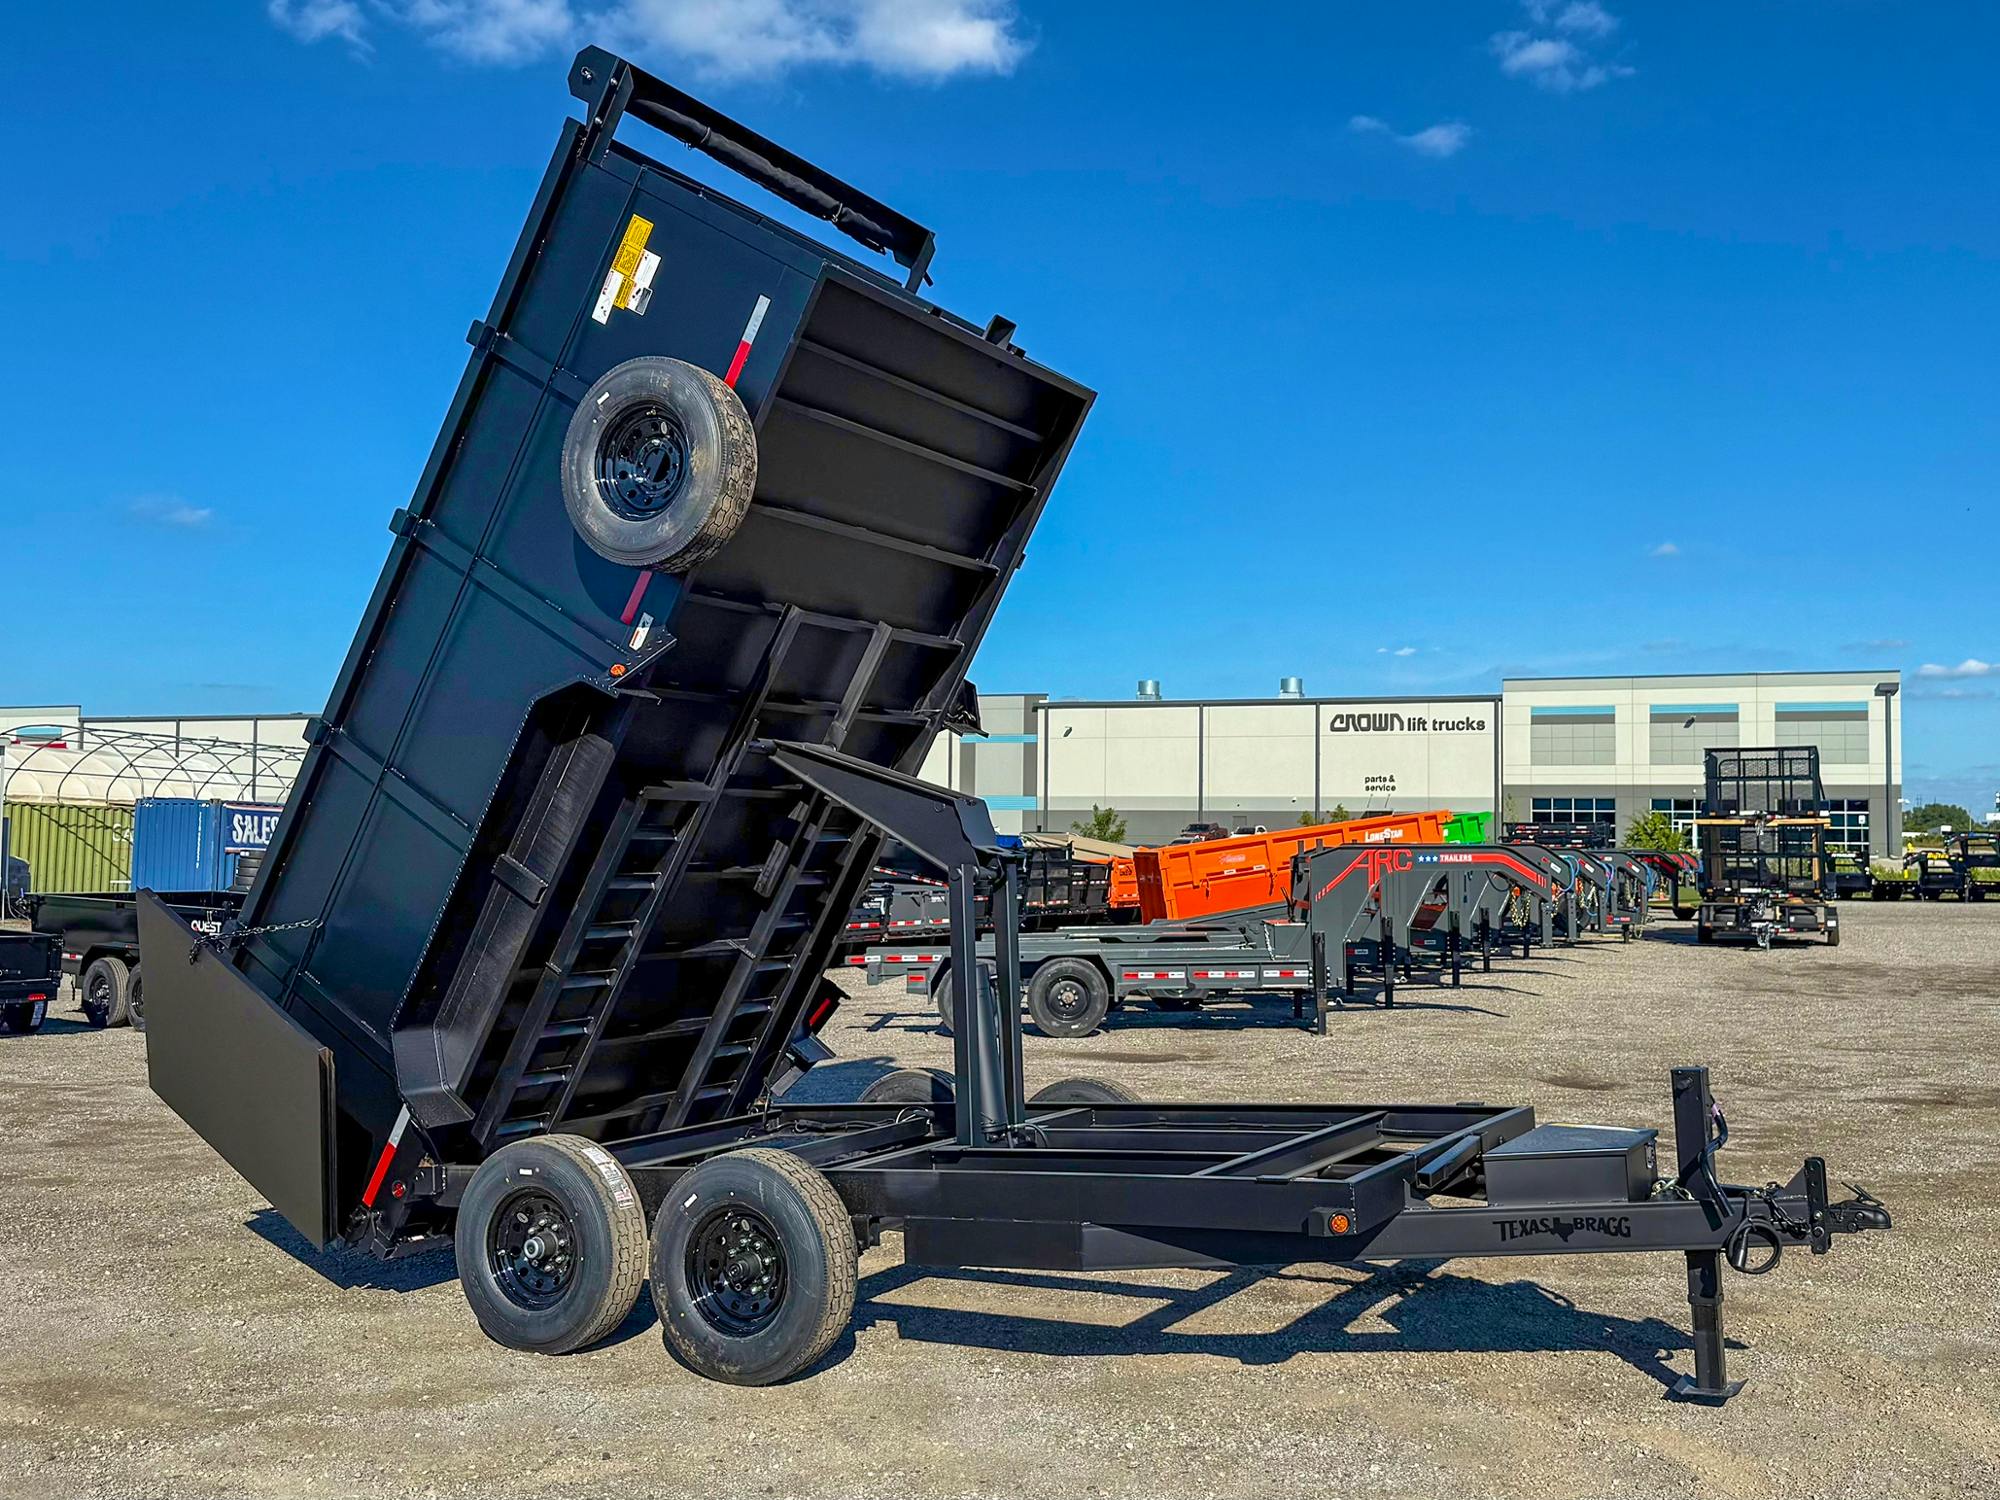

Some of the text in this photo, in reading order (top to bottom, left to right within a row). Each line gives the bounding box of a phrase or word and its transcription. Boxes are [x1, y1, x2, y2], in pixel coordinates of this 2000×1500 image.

[1330, 713, 1486, 732] CROWN lift trucks
[1364, 774, 1395, 783] parts &
[1364, 784, 1397, 792] service
[1330, 848, 1473, 891] ARC TRAILERS
[191, 919, 222, 933] QUEST
[1493, 1216, 1631, 1242] TEXAS BRAGG
